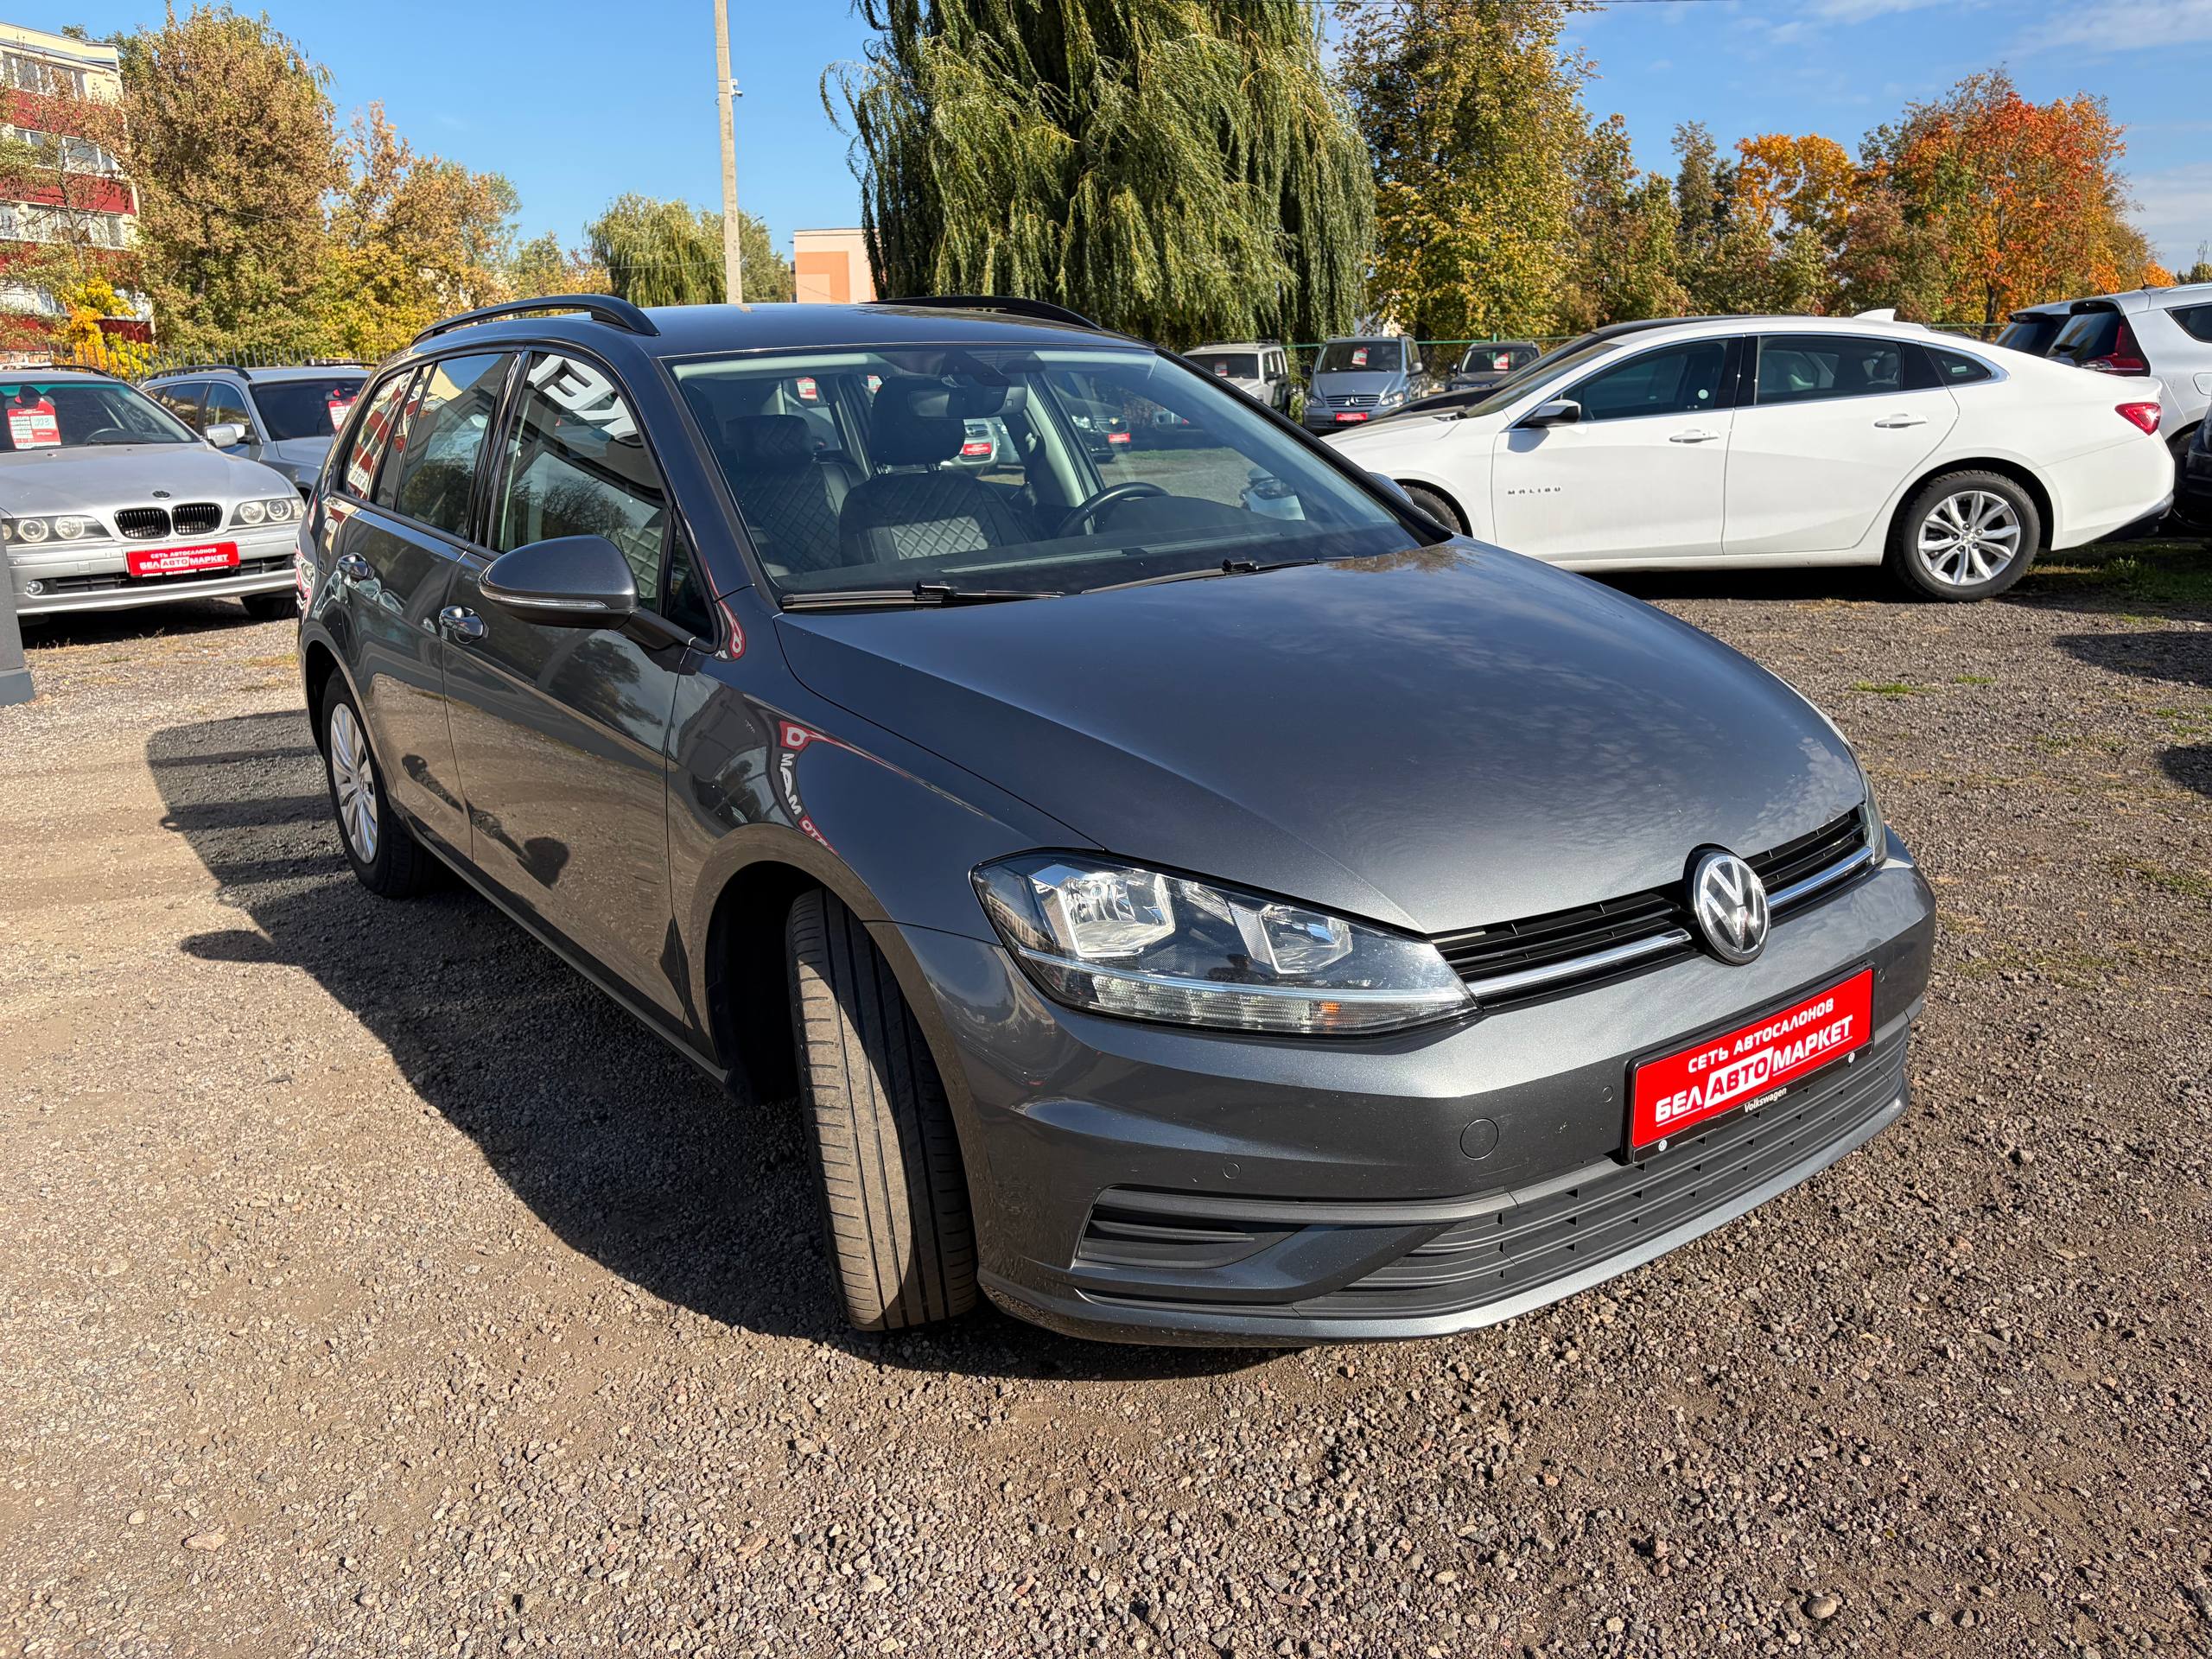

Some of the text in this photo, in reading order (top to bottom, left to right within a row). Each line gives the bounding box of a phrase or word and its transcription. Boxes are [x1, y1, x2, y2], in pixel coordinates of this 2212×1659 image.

[1507, 486, 1561, 495] MALIBU
[1688, 997, 1834, 1073] СЕТЬ АВТОСАЛОНОВ
[1744, 1087, 1788, 1113] Volkswagen
